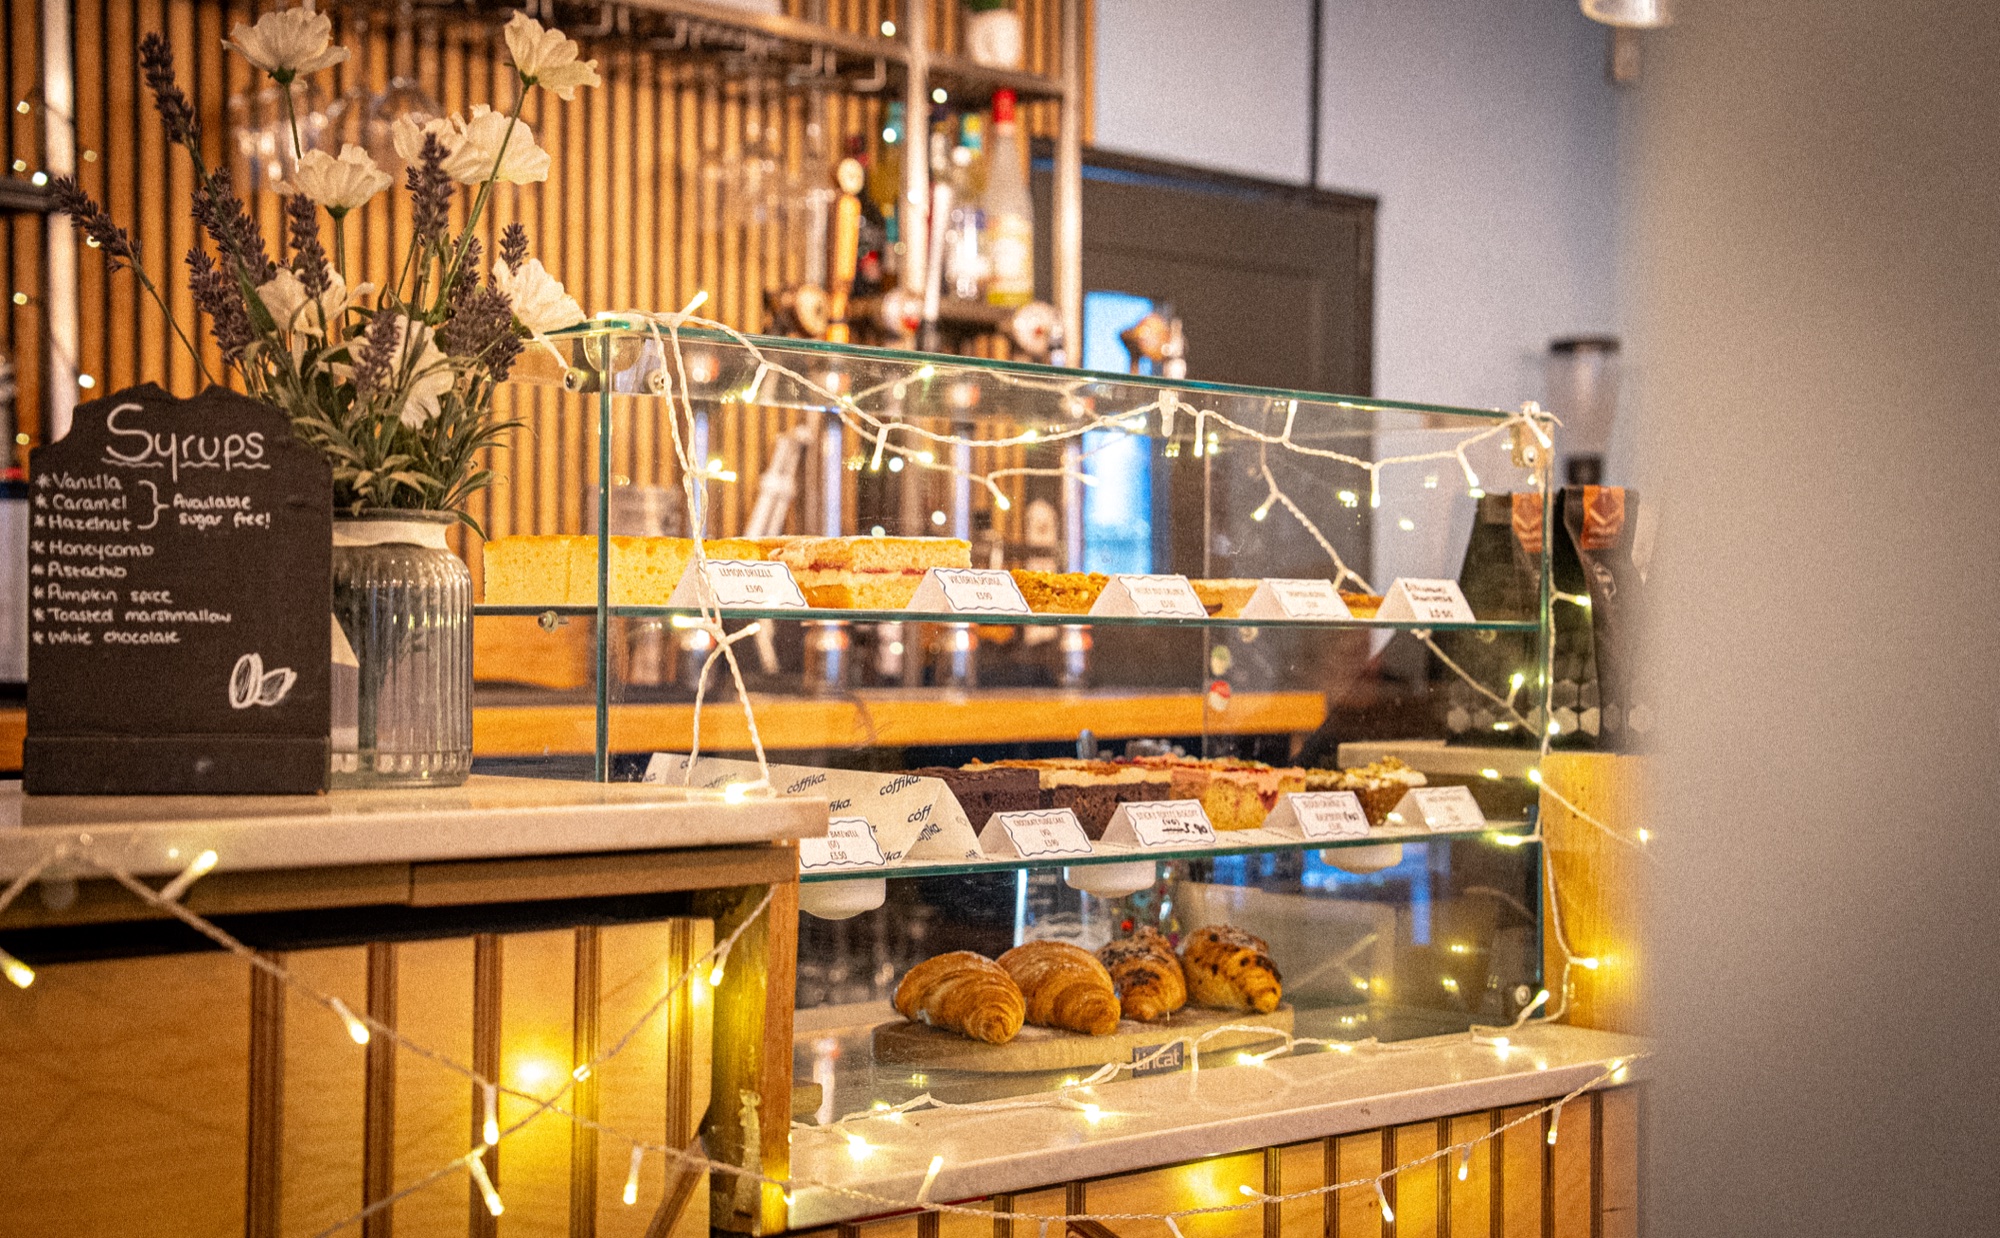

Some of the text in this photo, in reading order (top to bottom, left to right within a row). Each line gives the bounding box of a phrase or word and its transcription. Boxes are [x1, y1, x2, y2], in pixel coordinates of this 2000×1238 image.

[106, 403, 264, 482] Syrups
[53, 472, 122, 490] Vanilla
[53, 494, 127, 511] Caramel
[173, 493, 251, 509] Available
[49, 514, 131, 532] Hazelnut
[233, 511, 271, 529] free!
[49, 540, 154, 560] Honeycomb
[48, 561, 127, 578] Pistachio
[48, 583, 174, 604] Pumpkin spice
[47, 608, 231, 623] Toasted marshmallow
[48, 628, 181, 644] White chocolate
